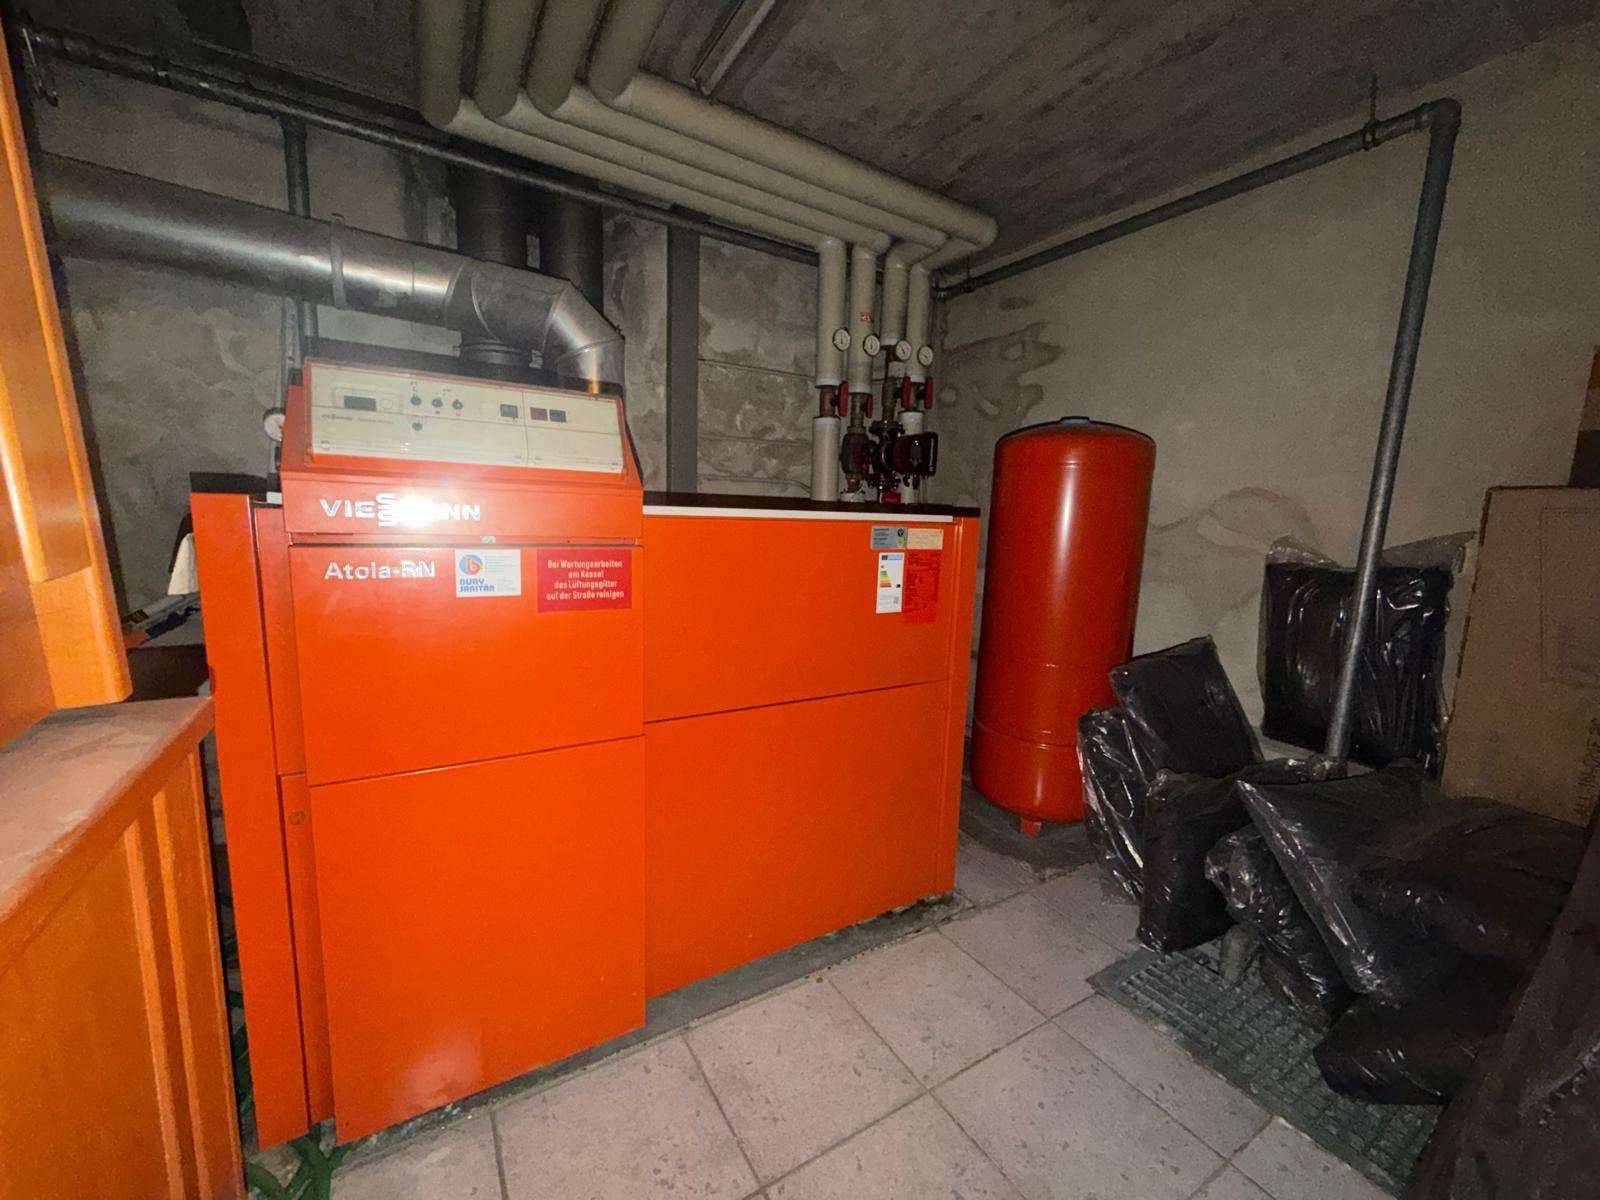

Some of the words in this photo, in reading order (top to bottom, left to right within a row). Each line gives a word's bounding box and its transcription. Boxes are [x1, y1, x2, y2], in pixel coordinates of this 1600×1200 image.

[319, 492, 481, 527] VIESSNN
[547, 560, 559, 568] Bei
[560, 560, 623, 569] Wartungsarbeiten
[324, 560, 436, 580] Atola-RN
[581, 570, 604, 578] Kessel
[554, 581, 567, 589] das
[568, 580, 618, 590] Lüftungsgitter
[546, 592, 559, 600] auf
[560, 591, 571, 599] der
[573, 590, 595, 599] Straße
[596, 591, 625, 600] reinigen
